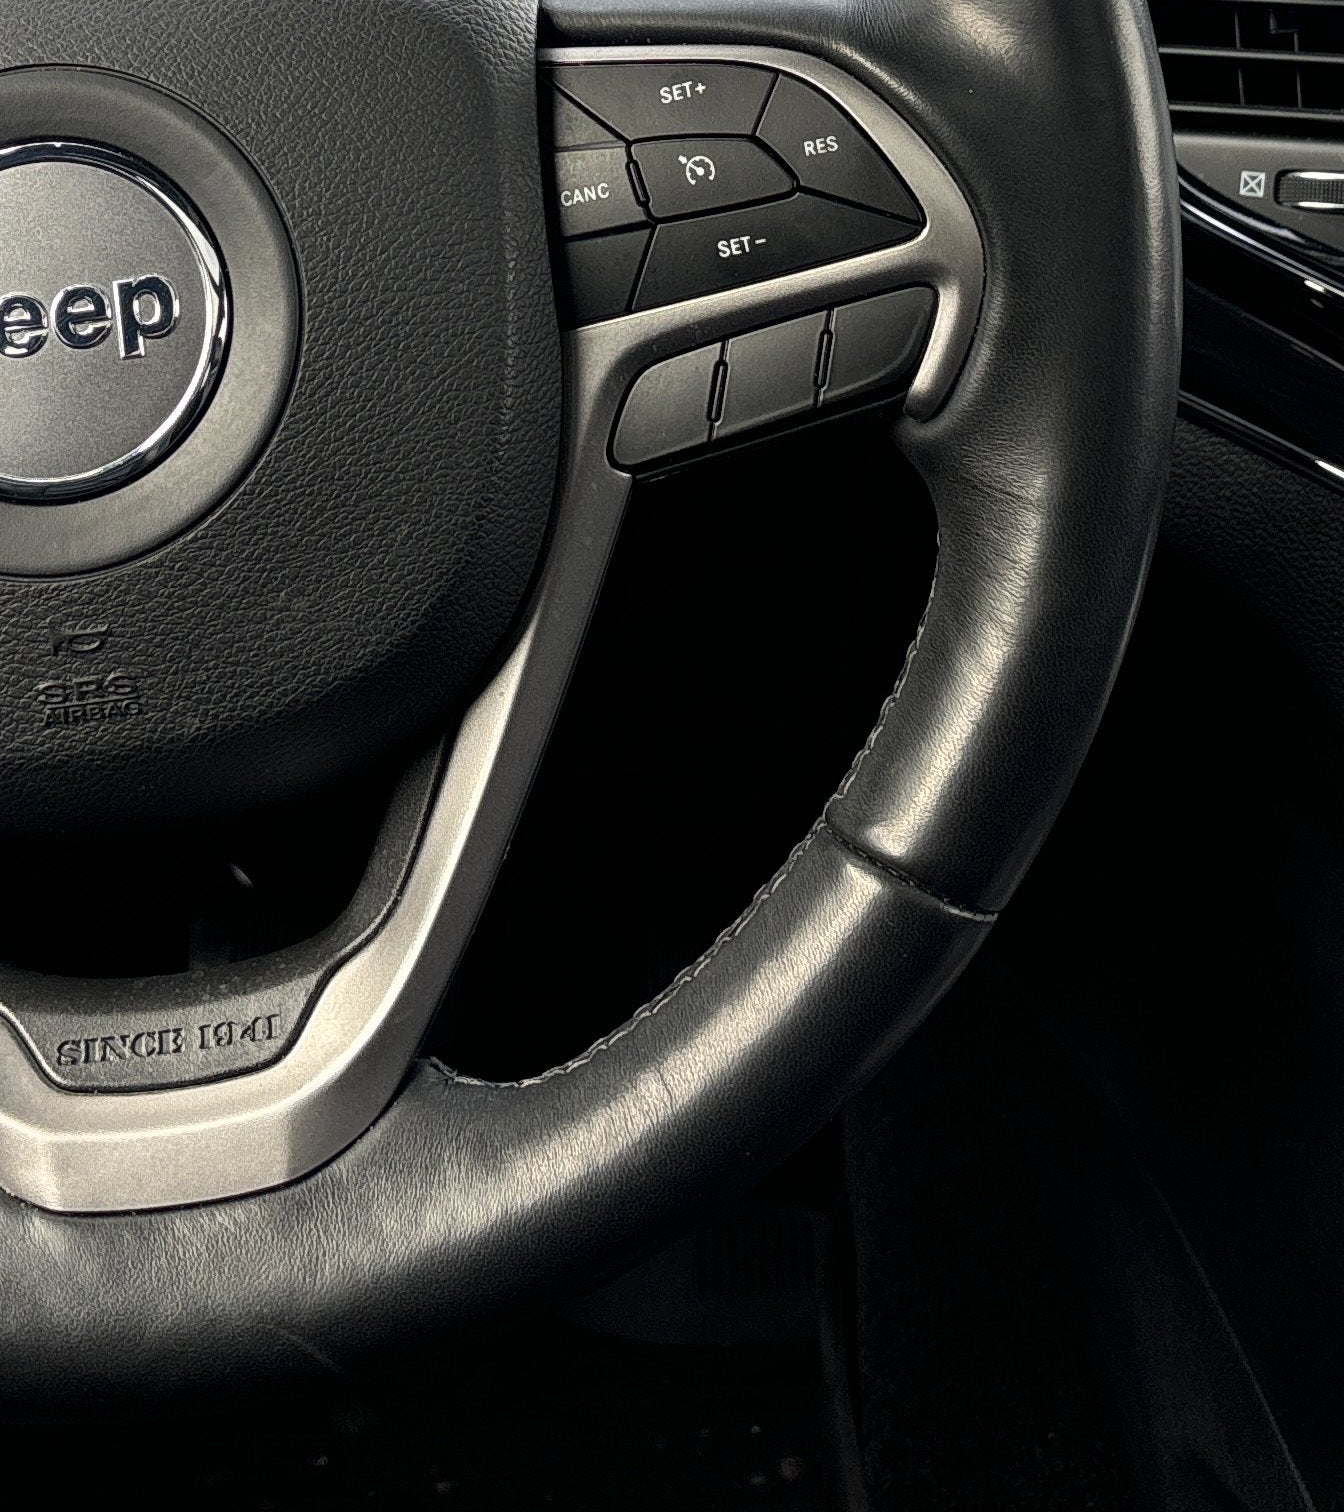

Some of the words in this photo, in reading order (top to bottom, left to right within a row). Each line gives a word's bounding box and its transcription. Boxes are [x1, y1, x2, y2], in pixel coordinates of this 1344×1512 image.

[803, 136, 839, 157] RES
[560, 183, 610, 207] CANC
[37, 670, 138, 703] SRS
[43, 701, 143, 727] AIRBAG
[56, 1027, 184, 1066] SINCE
[197, 1014, 281, 1050] 1941
